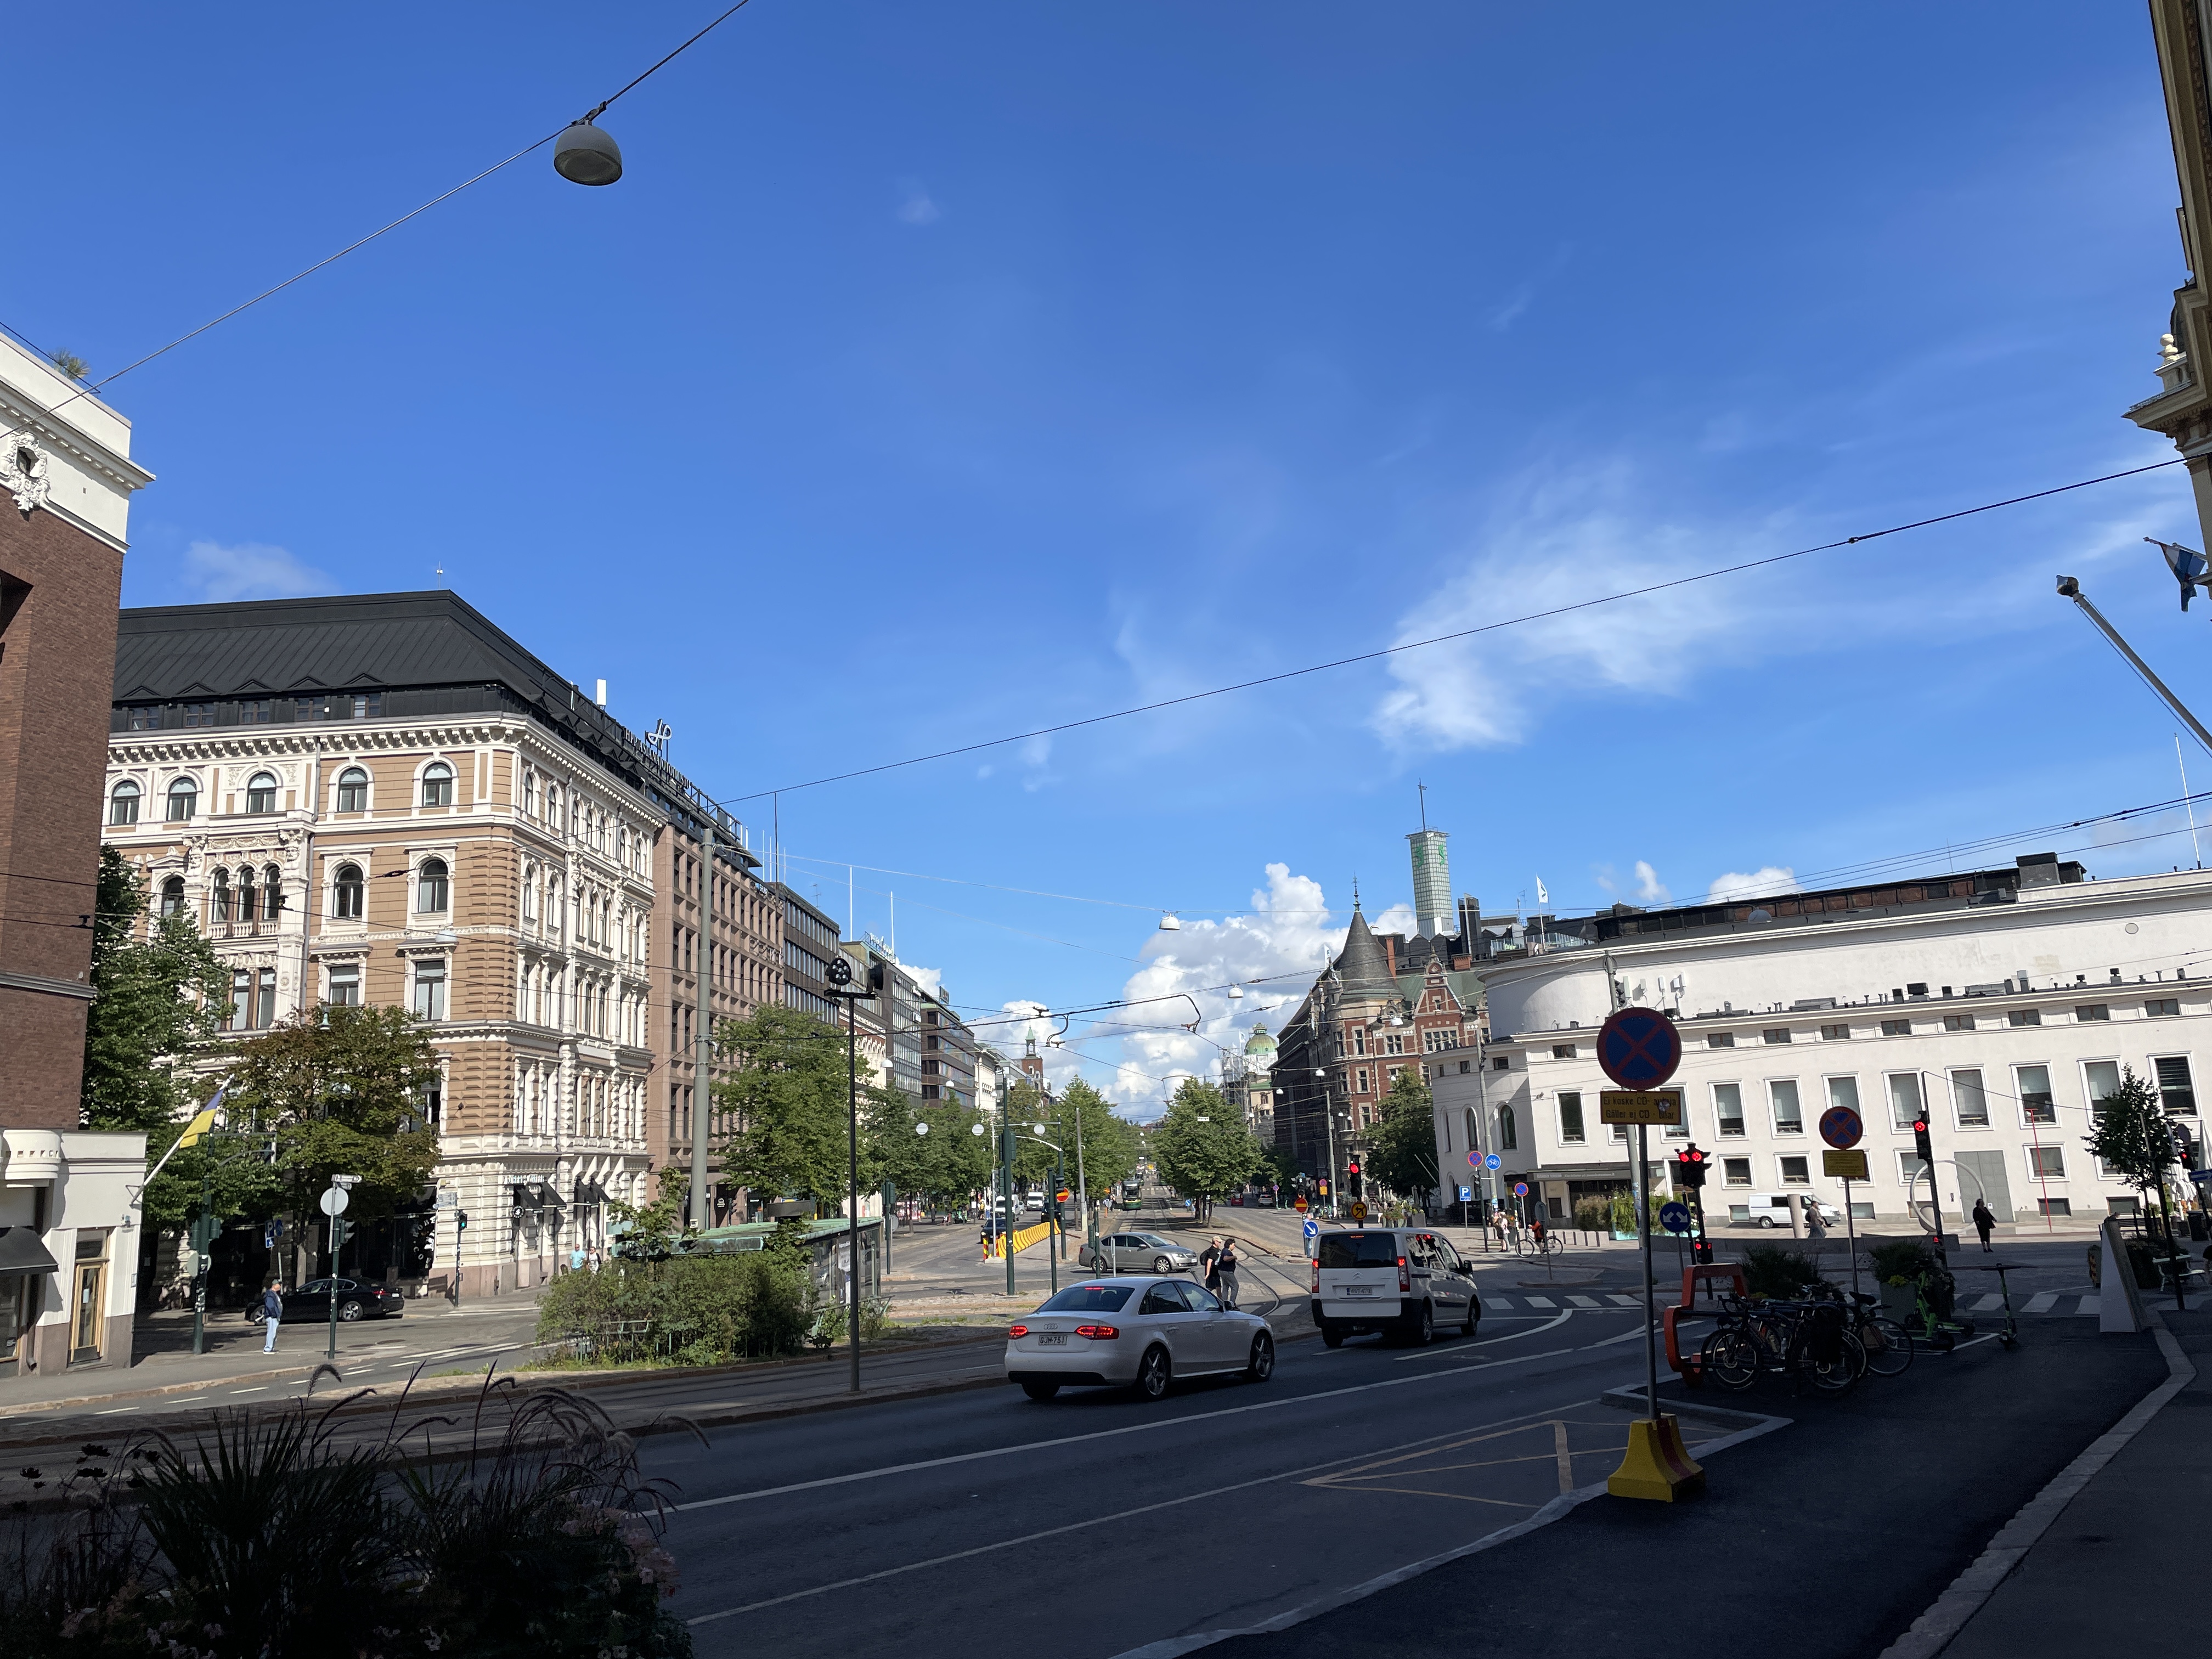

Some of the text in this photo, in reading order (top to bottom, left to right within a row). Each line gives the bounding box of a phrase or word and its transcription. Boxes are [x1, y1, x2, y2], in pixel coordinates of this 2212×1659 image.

[1604, 1097, 1610, 1105] Ei
[1613, 1097, 1634, 1105] koske
[1606, 1109, 1626, 1118] Gäller
[1629, 1111, 1636, 1120] ej
[1462, 1187, 1469, 1197] P
